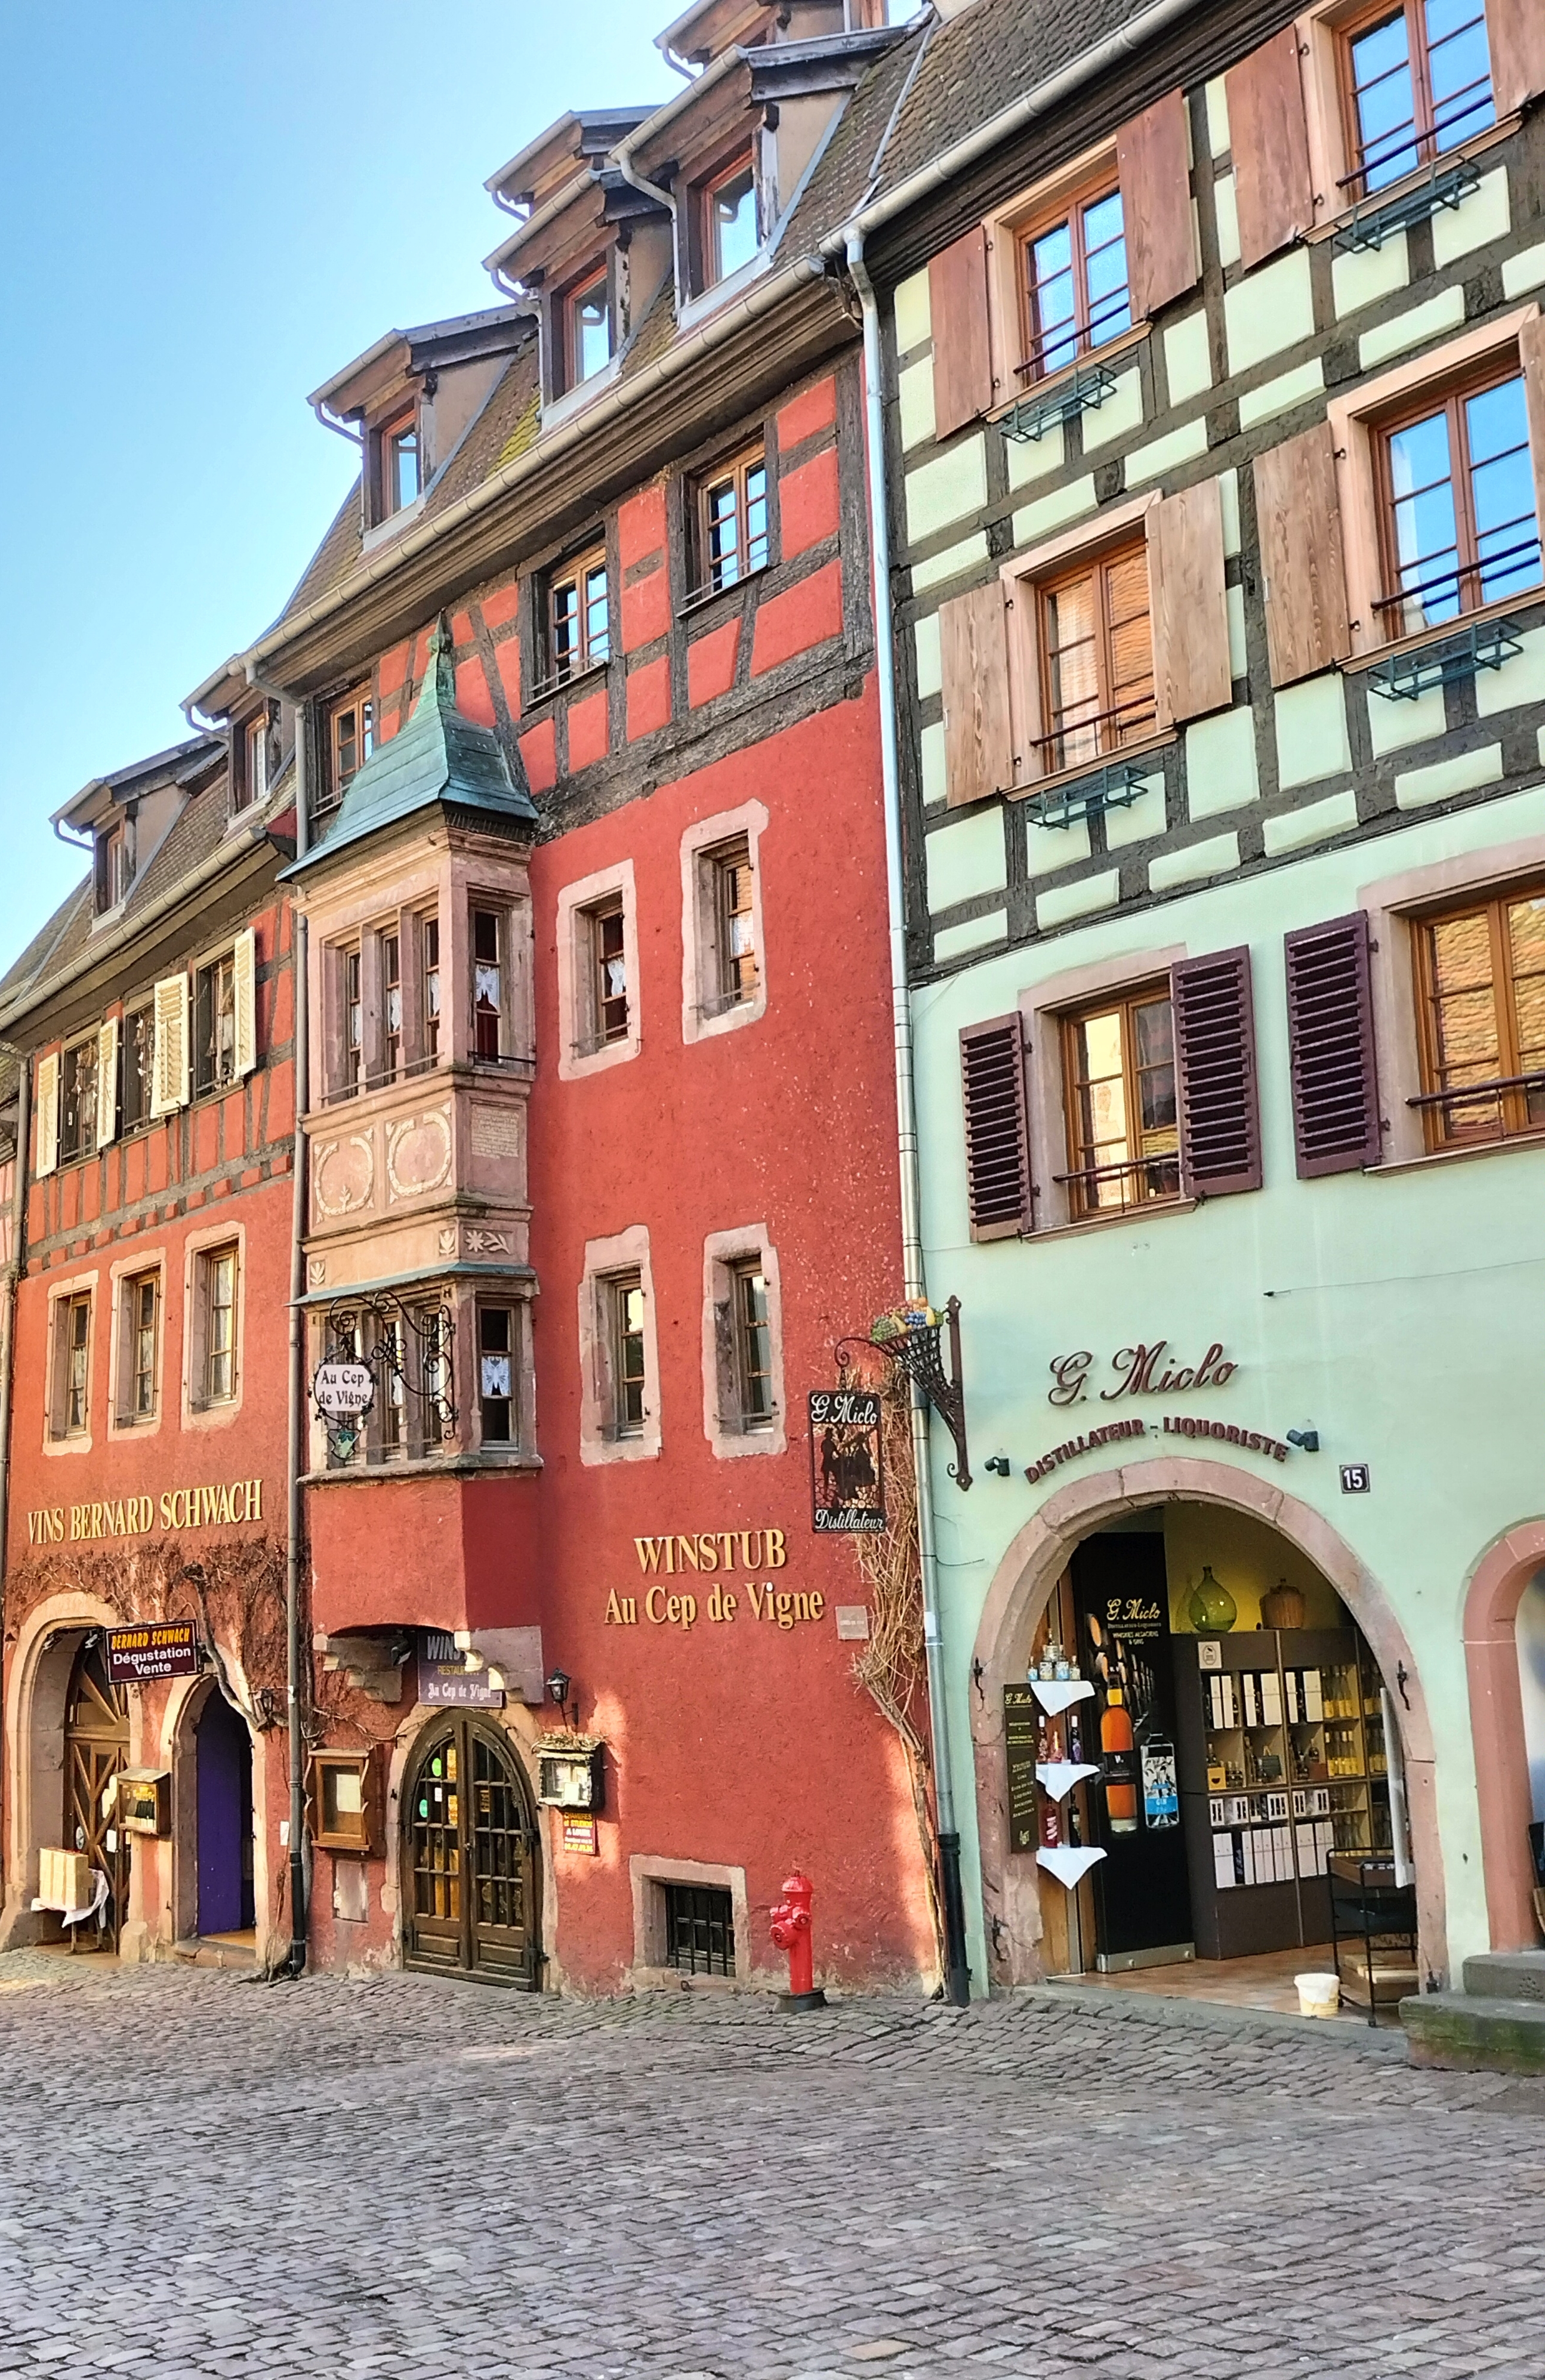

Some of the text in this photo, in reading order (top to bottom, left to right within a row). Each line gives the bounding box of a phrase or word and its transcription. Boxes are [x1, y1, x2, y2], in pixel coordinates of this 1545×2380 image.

[320, 1370, 365, 1388] Au Cep
[1099, 1341, 1239, 1401] Miclo
[318, 1390, 368, 1408] de Vigne
[830, 1395, 878, 1425] Miclo
[1023, 1418, 1147, 1485] DISTILLATEUR
[1162, 1416, 1290, 1464] LIQUORISTE
[1343, 1468, 1363, 1489] 15
[27, 1478, 263, 1545] VINS BERNARD SCHWACH
[815, 1509, 884, 1530] Distillateur
[633, 1528, 787, 1575] WINSTUB
[604, 1581, 824, 1631] Au Cep de Vigne
[1122, 1598, 1161, 1620] Miclo
[112, 1628, 190, 1650] BERNARD SCHWACH
[113, 1647, 192, 1665] Dégustation
[135, 1662, 172, 1675] Vente
[437, 1665, 480, 1676] RESTAU
[427, 1682, 492, 1701] Au Cep de Vigne
